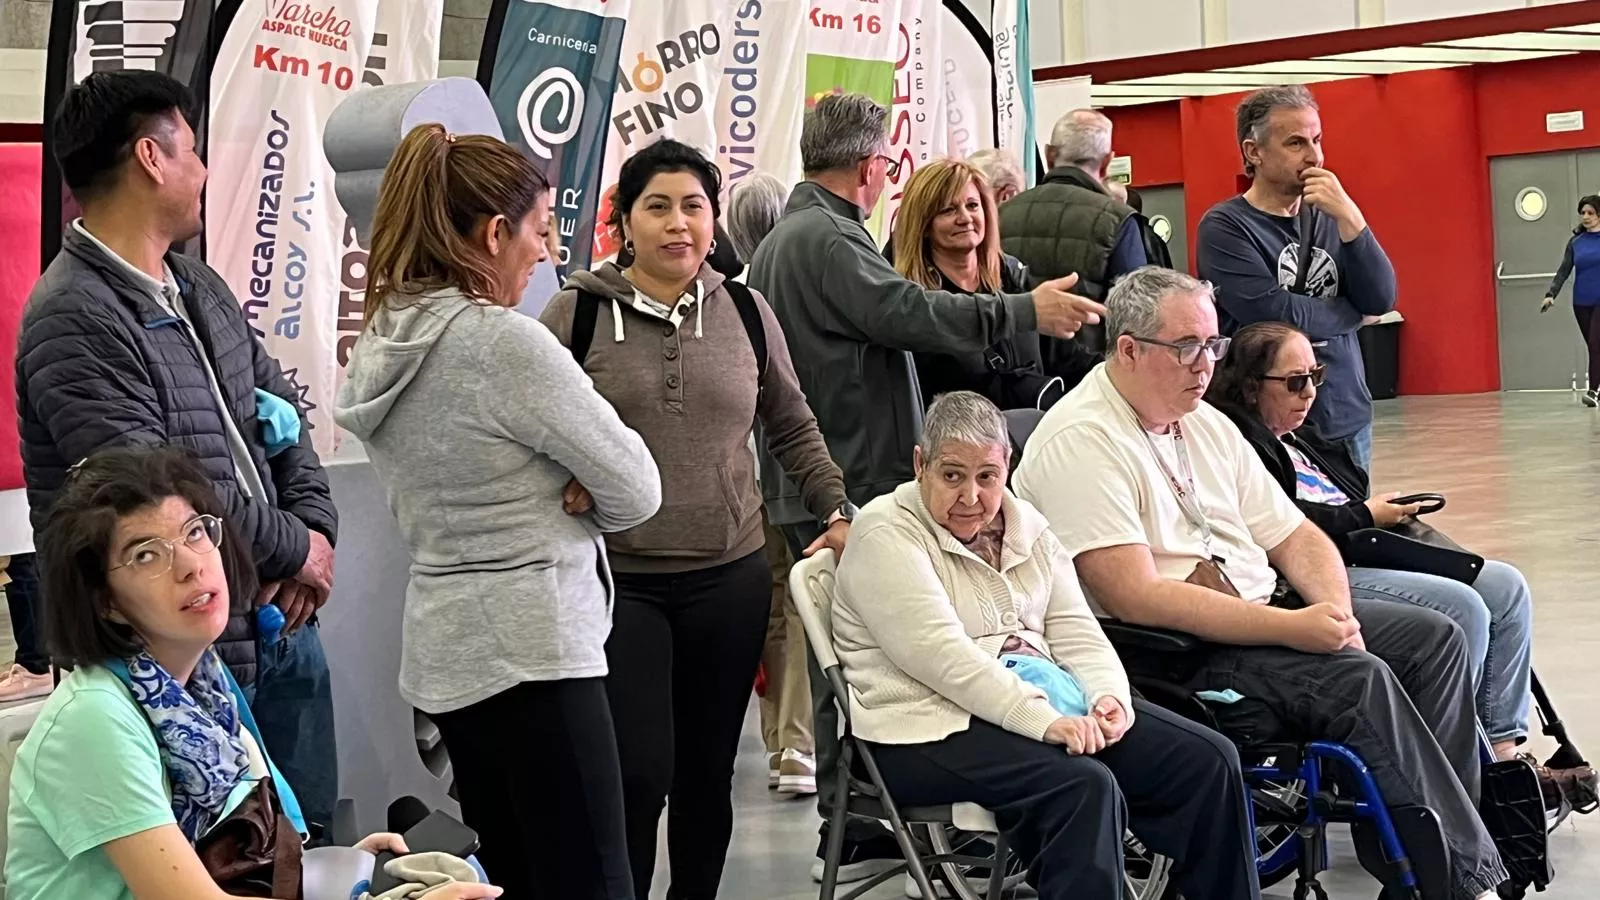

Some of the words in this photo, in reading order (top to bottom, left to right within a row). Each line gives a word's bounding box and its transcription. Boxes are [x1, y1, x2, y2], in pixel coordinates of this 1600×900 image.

[261, 19, 307, 38] ASPACE
[308, 29, 349, 52] HUESCA
[852, 13, 882, 35] 16
[253, 44, 310, 77] Km
[317, 60, 354, 91] 10
[914, 17, 927, 122] Company
[612, 81, 704, 146] FINO
